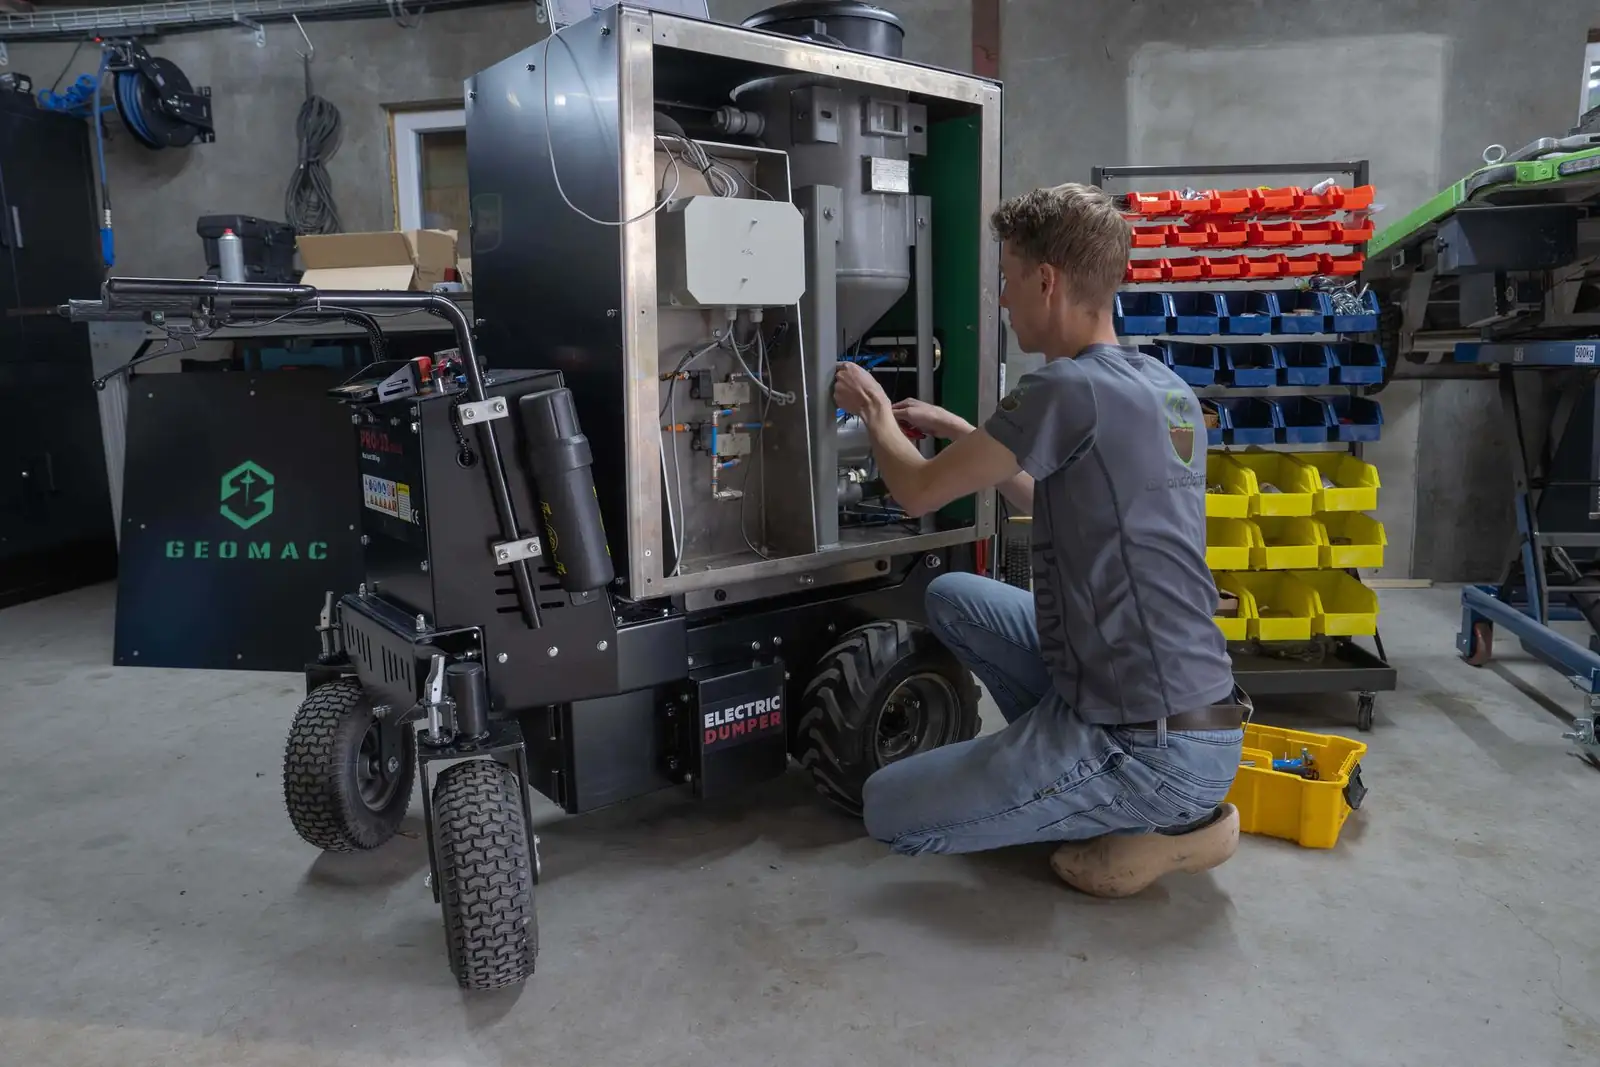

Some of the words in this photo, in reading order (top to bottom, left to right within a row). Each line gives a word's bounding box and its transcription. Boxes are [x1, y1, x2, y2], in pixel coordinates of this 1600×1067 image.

[1576, 347, 1593, 360] 500kg
[165, 540, 327, 560] GEOMAC
[704, 695, 781, 729] ELECTRIC
[704, 711, 781, 745] DUMPER
